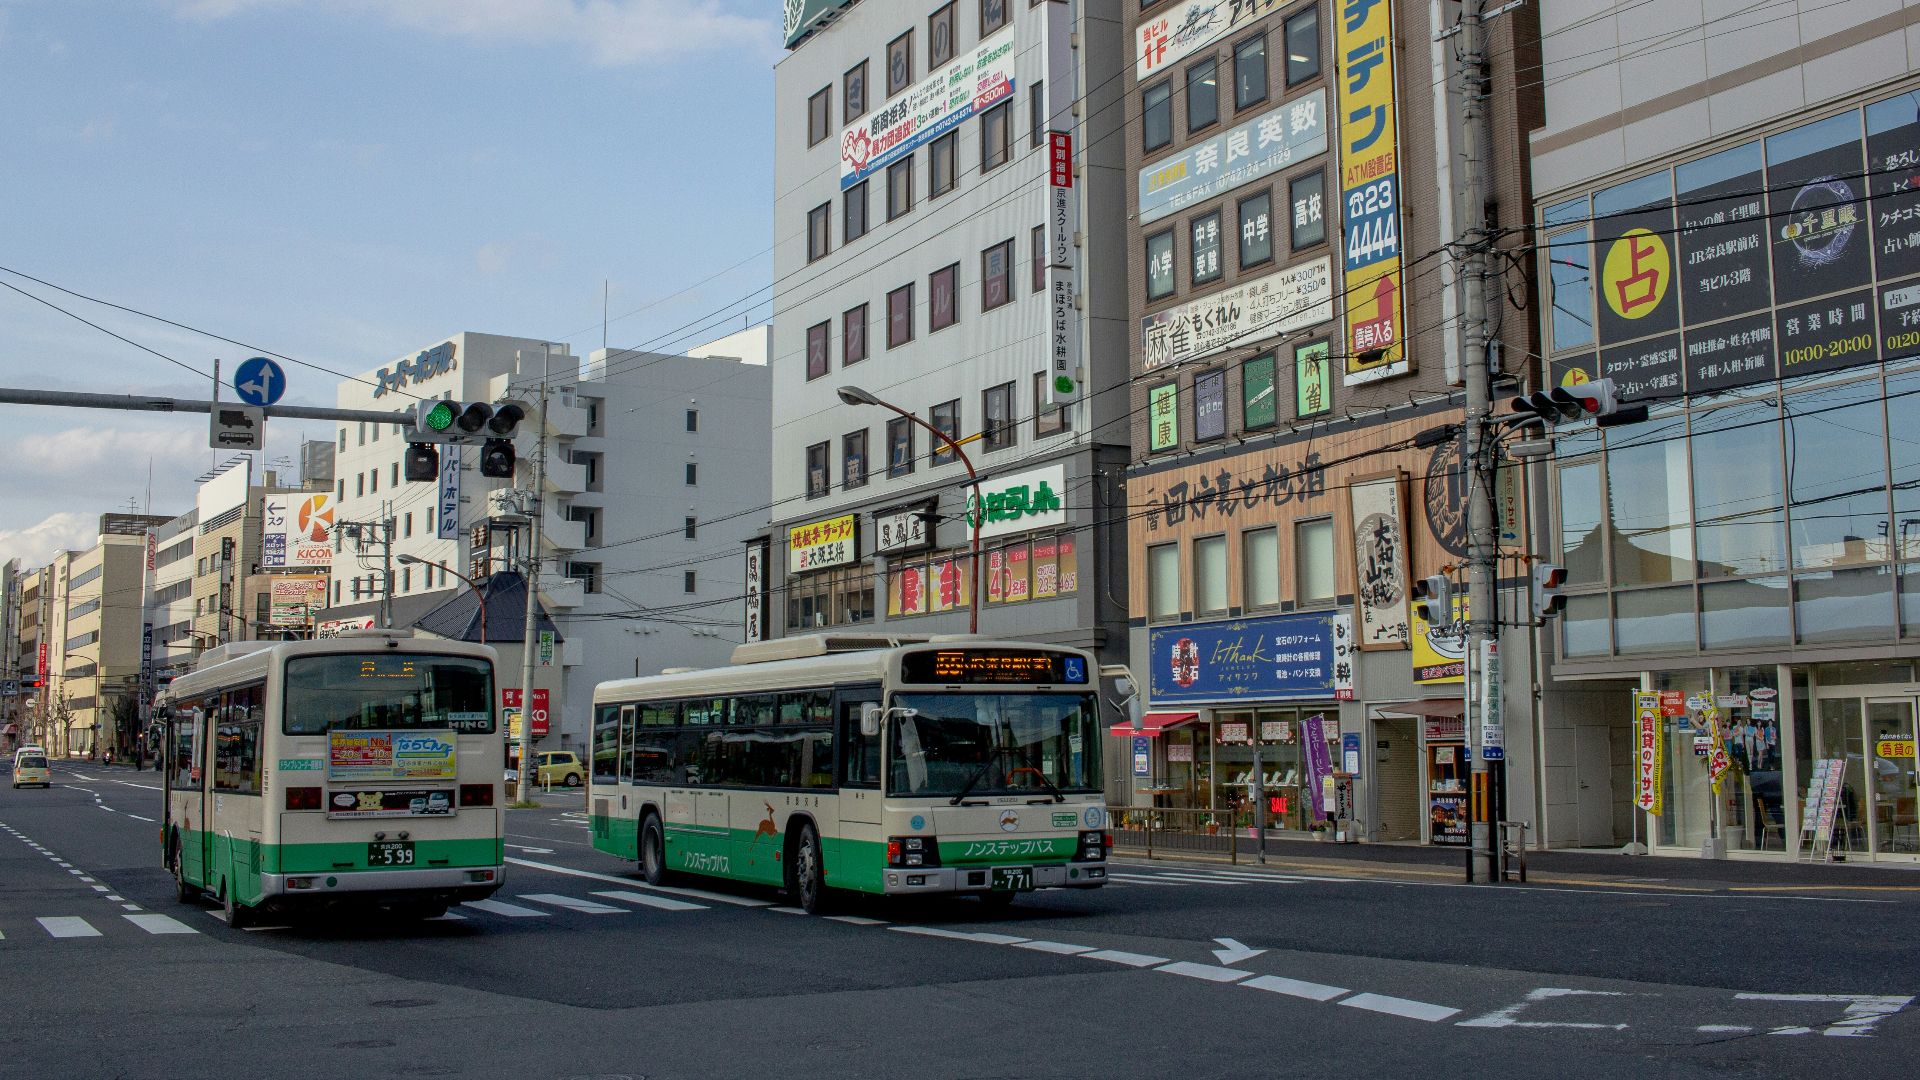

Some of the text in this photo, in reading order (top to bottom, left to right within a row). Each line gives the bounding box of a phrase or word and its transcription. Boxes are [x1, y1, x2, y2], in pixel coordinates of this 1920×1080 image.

[1143, 19, 1169, 42] 当ビル
[1144, 35, 1167, 69] 1F
[1195, 100, 1318, 176] 奈良英数
[1055, 135, 1066, 185] 個別指導
[1346, 152, 1392, 186] ATM設置店
[1294, 193, 1322, 228] 高校
[1728, 201, 1760, 221] 千里眼
[1802, 203, 1858, 234] 千里眼
[1195, 217, 1218, 245] 中学
[1243, 213, 1269, 247] 中学
[1348, 213, 1397, 264] 4444
[1150, 250, 1173, 280] 小学
[1196, 250, 1218, 278] 受験
[1688, 234, 1760, 265] JR奈良駅前店
[1615, 237, 1659, 313] 占
[1699, 267, 1752, 293] 当ビル3階
[1055, 281, 1067, 371] まほろば水耕園
[1192, 301, 1241, 333] もくれん
[1786, 302, 1866, 337] 営業時間
[1145, 315, 1191, 370] 麻雀
[374, 341, 455, 398] スーパーホテル
[267, 516, 285, 526] スグ
[808, 541, 845, 567] 大阪王将
[1275, 634, 1321, 646] 宝石のリフォーム
[1275, 668, 1321, 679] 電池・バンド交換
[449, 720, 489, 729] HINO
[1639, 716, 1654, 807] 賃貸のマサキ
[1881, 743, 1914, 756] 賃貸の
[1271, 798, 1288, 813] SALE
[684, 850, 731, 875] ノンステップバス
[964, 840, 1055, 857] ノンステップバス
